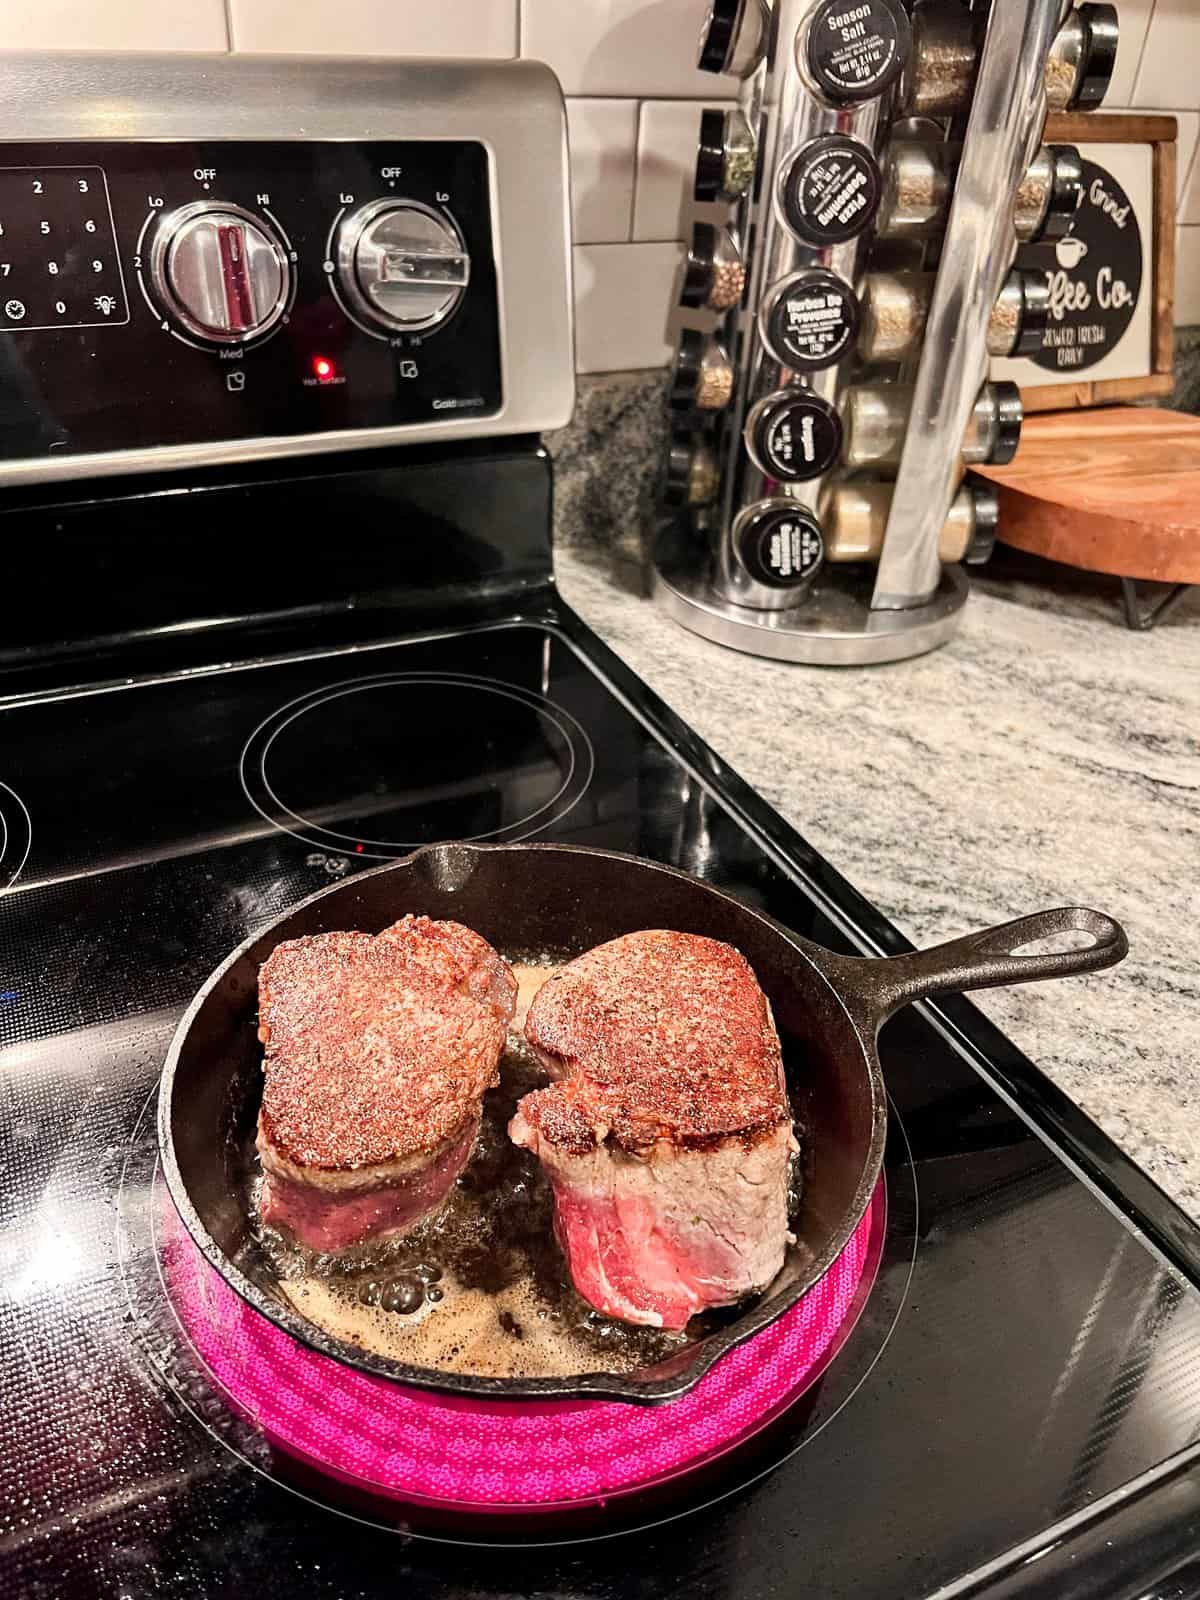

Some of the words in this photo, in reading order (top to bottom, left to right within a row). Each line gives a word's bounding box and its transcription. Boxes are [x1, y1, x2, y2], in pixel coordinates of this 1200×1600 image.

[827, 4, 872, 31] Season
[841, 21, 866, 42] Salt
[193, 169, 217, 181] OFF
[381, 168, 402, 178] OFF
[32, 181, 43, 194] 2
[78, 180, 89, 193] 3
[148, 196, 164, 208] Lo
[256, 194, 270, 206] Hi
[339, 193, 354, 204] Lo
[436, 192, 450, 202] Lo
[817, 171, 868, 227] Seasoning
[40, 221, 50, 234] 5
[85, 220, 96, 232] 6
[48, 262, 58, 274] 8
[93, 260, 103, 272] 9
[133, 256, 142, 268] 2
[1, 263, 11, 277] 7
[56, 301, 66, 314] 0
[219, 349, 244, 359] Med
